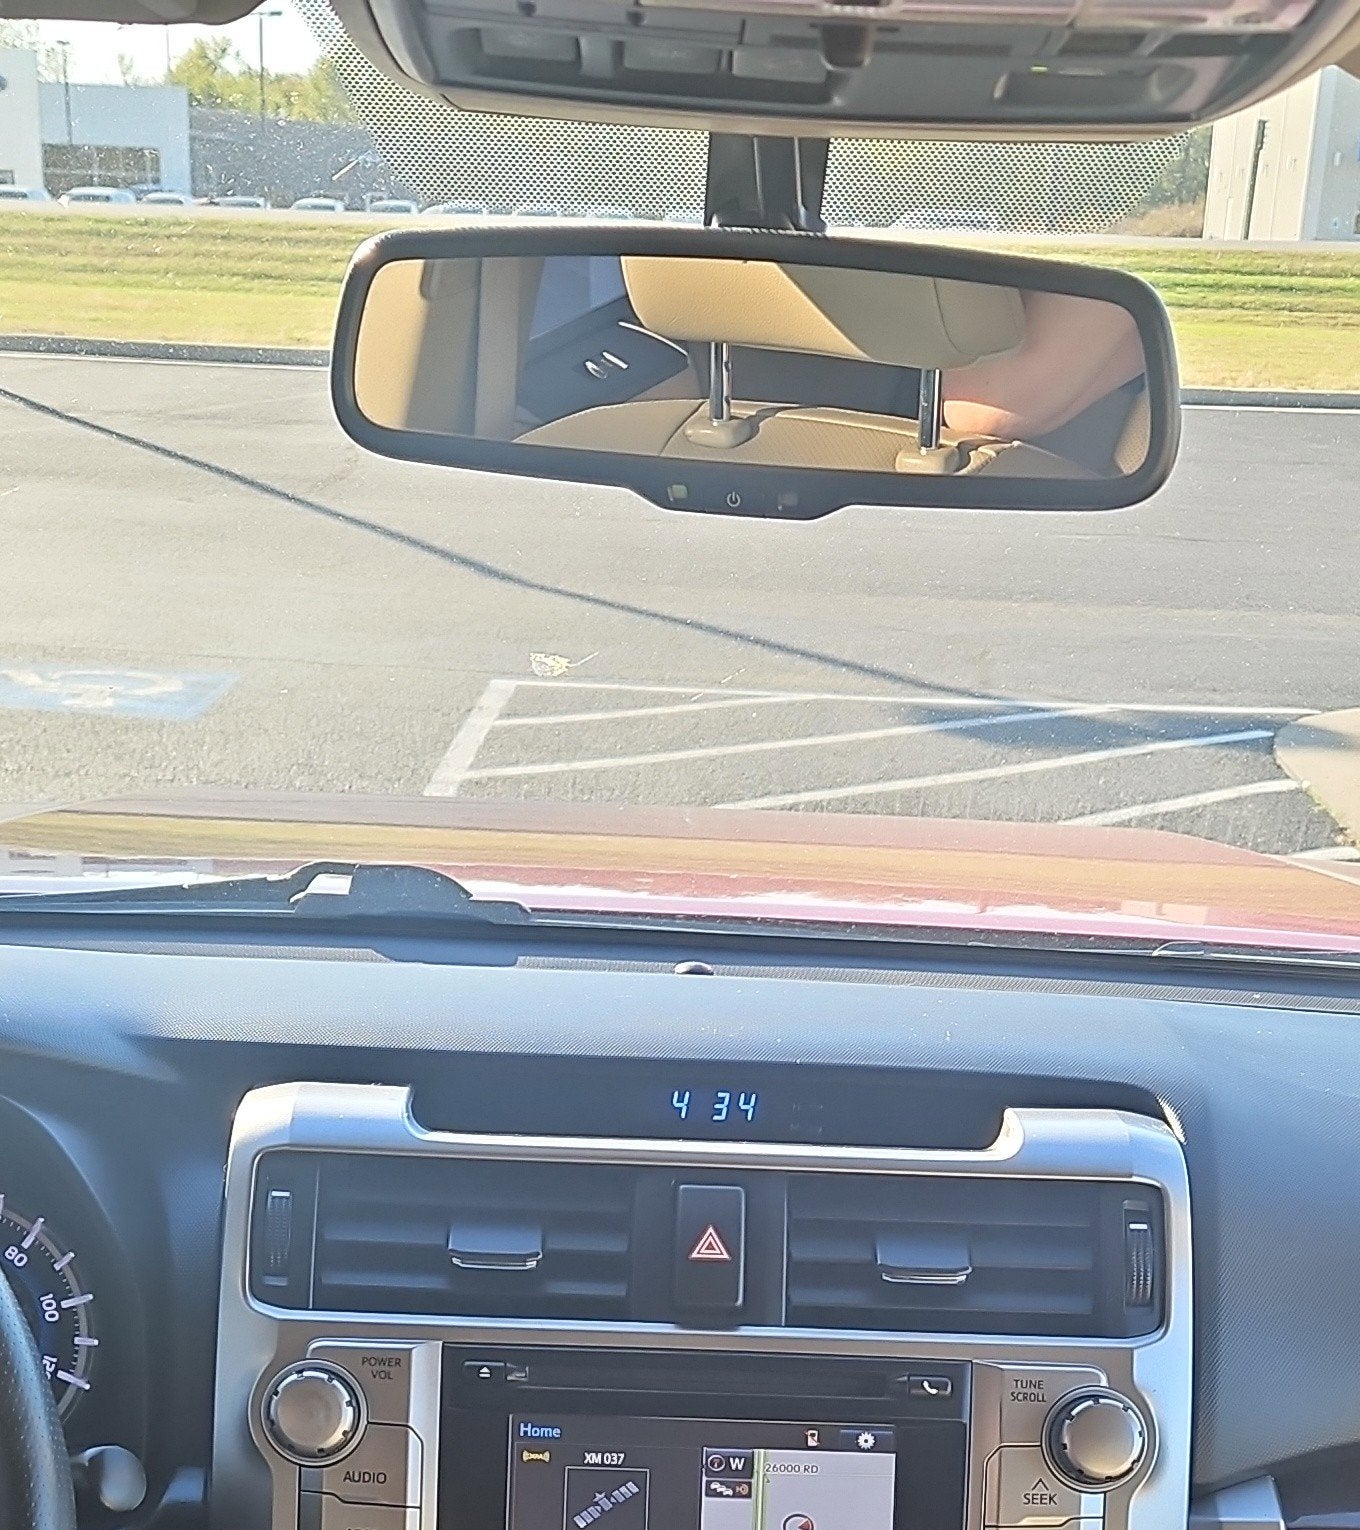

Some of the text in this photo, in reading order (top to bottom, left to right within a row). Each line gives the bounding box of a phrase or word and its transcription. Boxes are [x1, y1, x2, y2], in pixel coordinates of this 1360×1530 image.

[4, 1244, 29, 1268] 80
[39, 1292, 61, 1324] 100
[361, 1356, 402, 1368] POWER
[371, 1369, 394, 1380] VOL
[1013, 1378, 1044, 1390] TUNE
[1010, 1391, 1047, 1403] SCROLL
[519, 1422, 562, 1438] Home
[583, 1452, 625, 1465] XM 037
[728, 1457, 746, 1471] W
[765, 1463, 819, 1474] 26000 RD
[343, 1470, 388, 1485] AUDIO
[1023, 1493, 1058, 1506] SEEK
